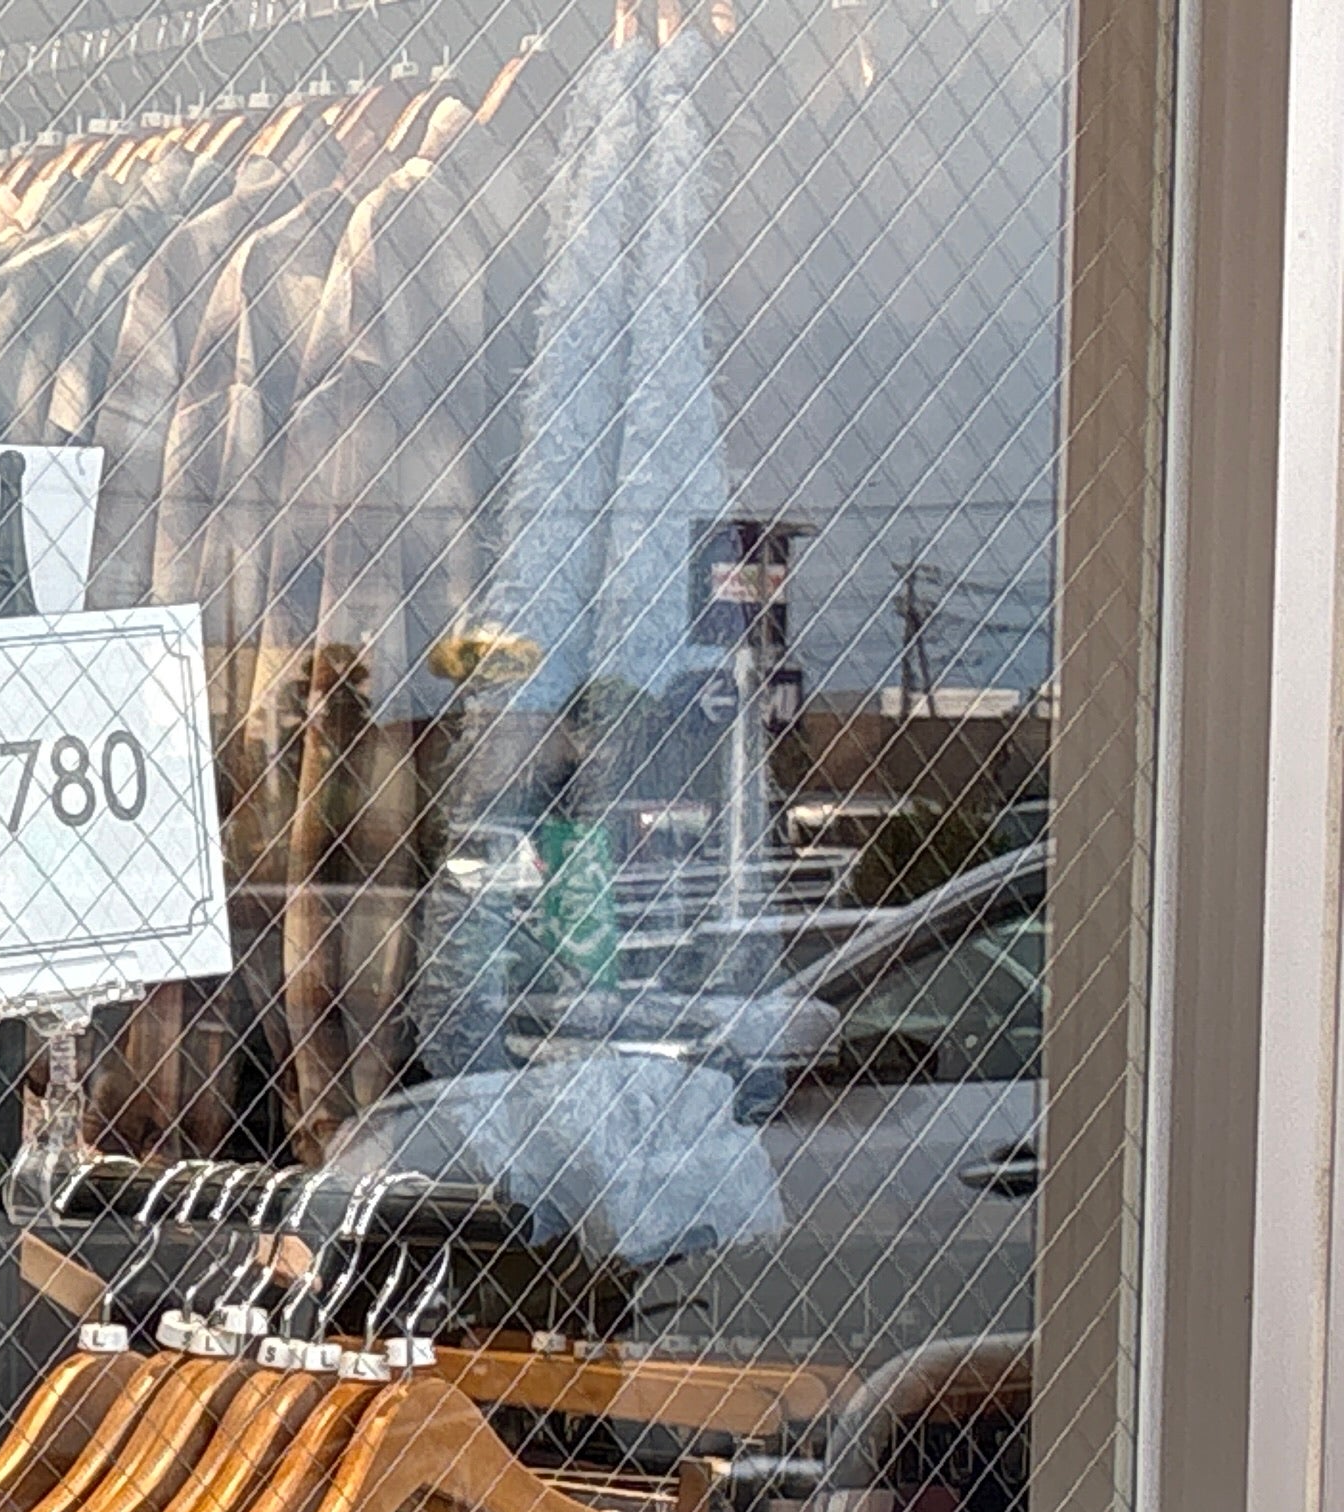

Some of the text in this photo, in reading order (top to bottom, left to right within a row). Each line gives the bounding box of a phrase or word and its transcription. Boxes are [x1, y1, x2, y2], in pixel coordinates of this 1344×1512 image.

[92, 1328, 105, 1347] L
[205, 1335, 216, 1351] L
[264, 1344, 277, 1363] S
[320, 1350, 334, 1368] L
[353, 1358, 366, 1377] L
